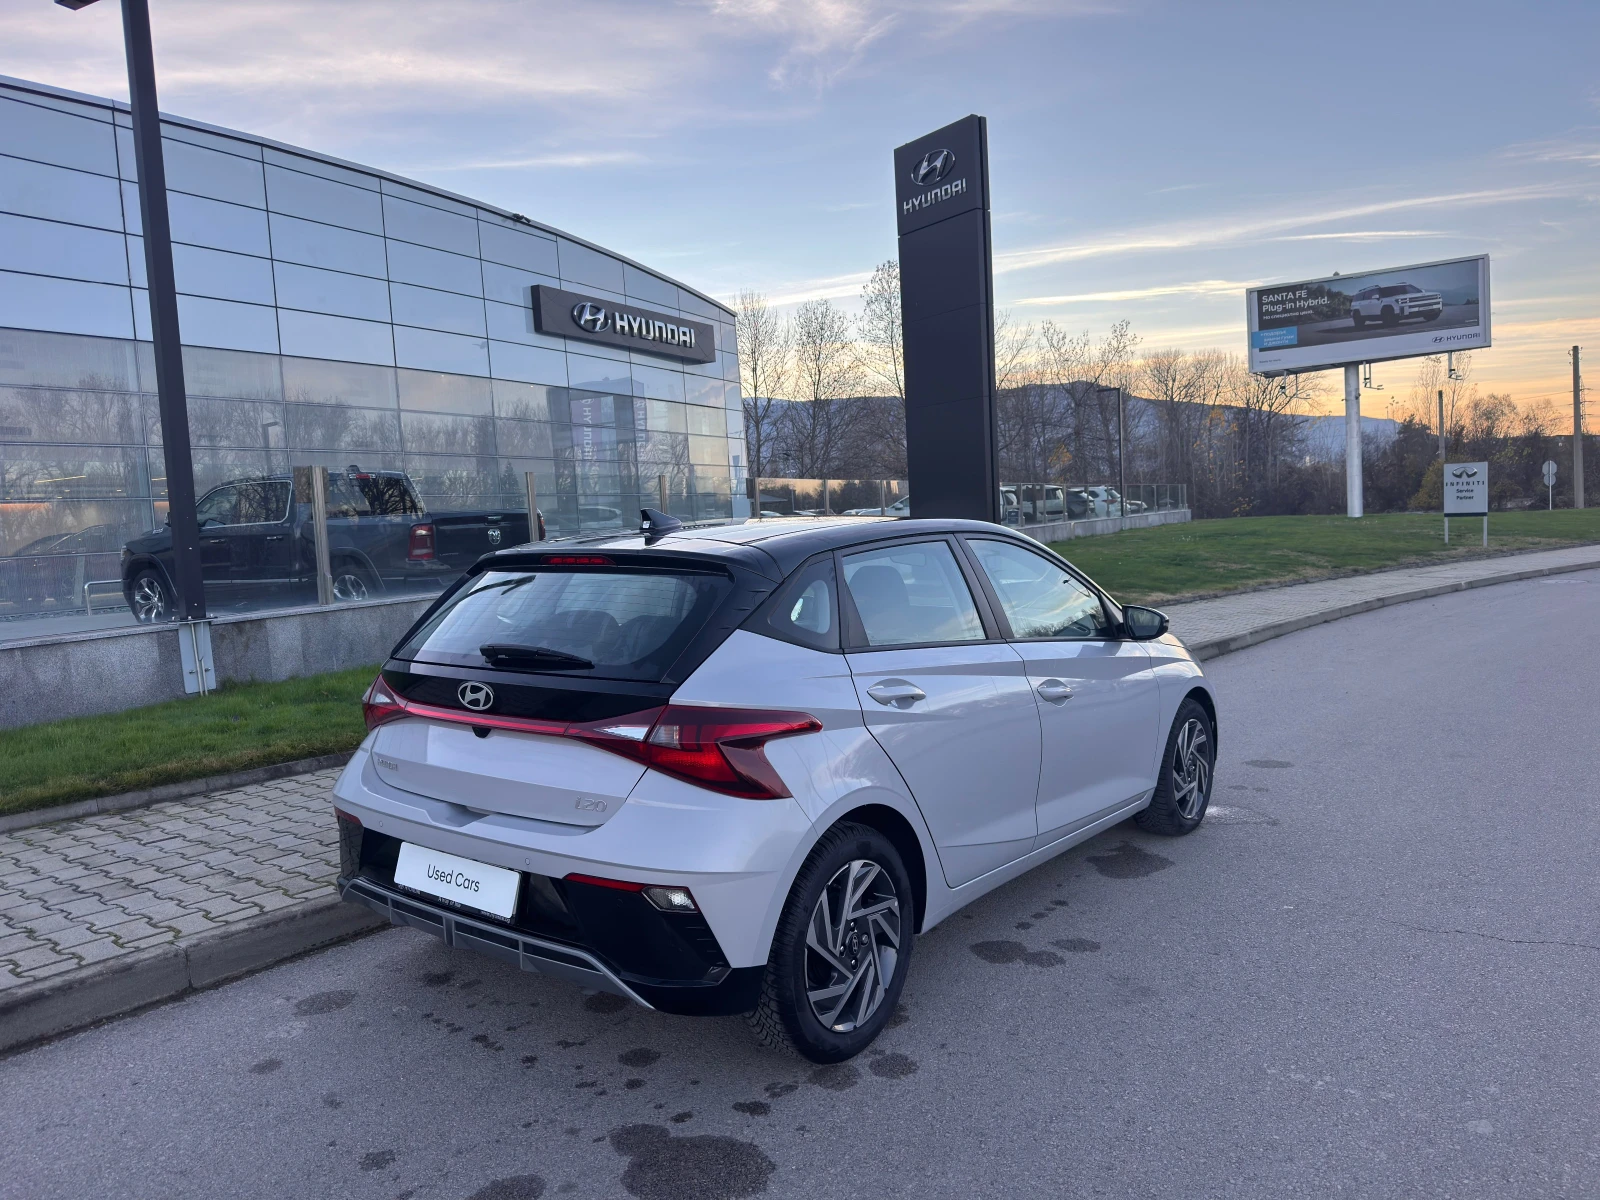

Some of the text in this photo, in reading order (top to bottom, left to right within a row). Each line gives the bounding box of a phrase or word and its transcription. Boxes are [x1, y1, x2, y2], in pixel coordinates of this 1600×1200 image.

[903, 178, 967, 215] HYUNDAI
[1262, 290, 1308, 303] SANTA FE
[1262, 296, 1330, 313] Plug-in Hybrid.
[613, 312, 696, 348] HYUNDAI
[1446, 332, 1481, 342] HYUNDAI
[575, 795, 608, 813] i20
[427, 863, 480, 892] Used Cars
